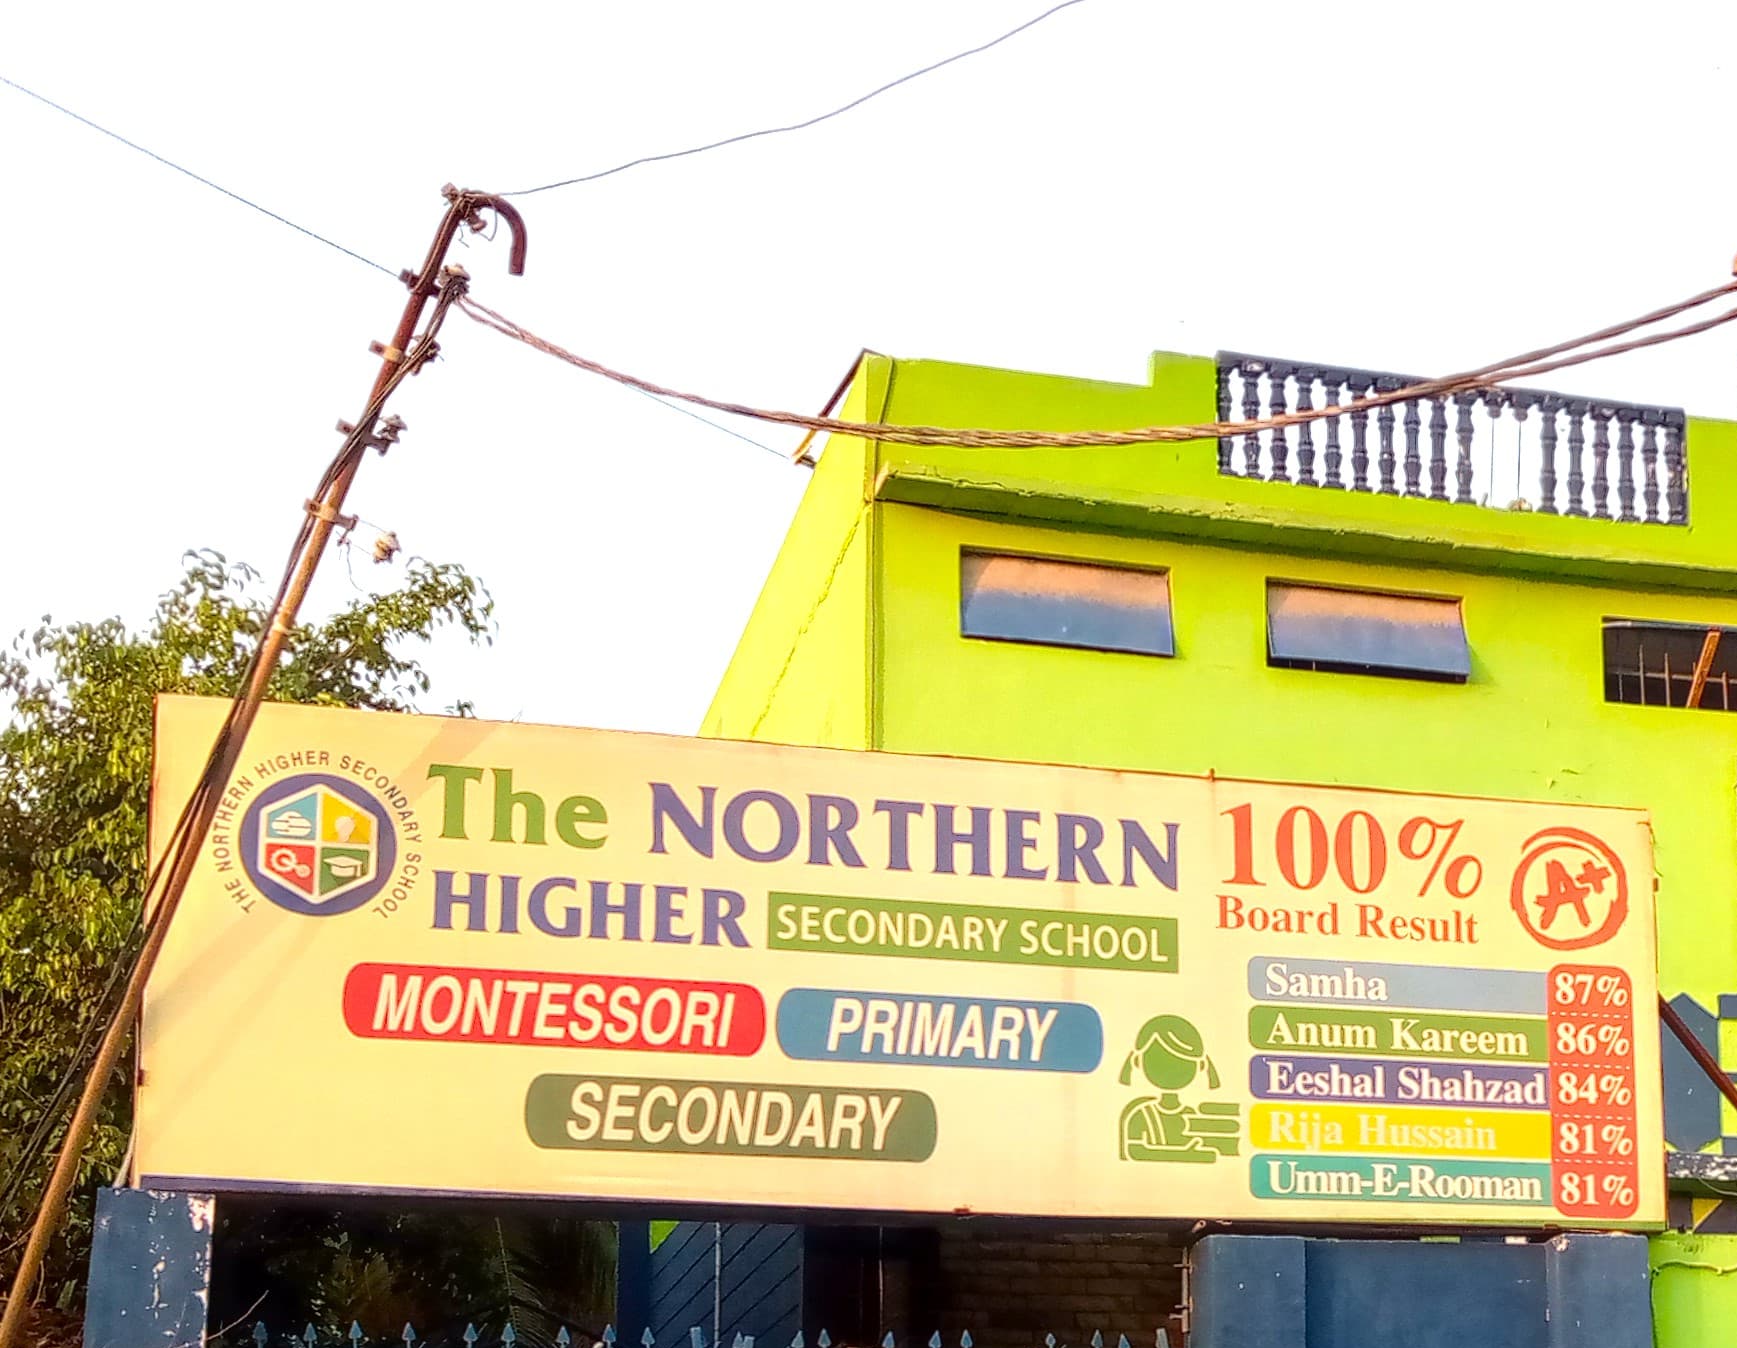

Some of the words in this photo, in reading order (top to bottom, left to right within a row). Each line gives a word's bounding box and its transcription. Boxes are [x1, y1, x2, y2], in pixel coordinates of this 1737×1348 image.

[254, 750, 330, 779] HIGHER
[213, 776, 254, 872] NORTHERN
[339, 755, 422, 843] SECONDARY
[427, 763, 608, 850] The
[647, 782, 1180, 892] NORTHERN
[1219, 803, 1483, 899] 100%
[224, 878, 256, 914] THE
[372, 852, 422, 919] SCHOOL
[430, 870, 751, 948] HIGHER
[776, 904, 1010, 953] SECONDARY
[1019, 919, 1169, 964] SCHOOL
[1215, 894, 1341, 936] Board
[1354, 903, 1479, 944] Result
[372, 974, 738, 1049] MONTESSORI
[1265, 962, 1388, 1002] Samha
[1554, 972, 1629, 1007] 87%
[826, 997, 1059, 1062] PRIMARY
[1266, 1012, 1377, 1049] Anum
[1389, 1018, 1529, 1056] Kareem
[1556, 1022, 1630, 1057] 86%
[1264, 1057, 1385, 1099] Eeshal
[1397, 1067, 1546, 1106] Shahzad
[1557, 1072, 1632, 1107] 84%
[565, 1081, 903, 1151] SECONDARY
[1269, 1111, 1343, 1150] Rija
[1358, 1114, 1497, 1152] Hussain
[1559, 1122, 1633, 1157] 81%
[1267, 1160, 1543, 1202] Umm-E-Rooman
[1560, 1172, 1634, 1207] 81%
